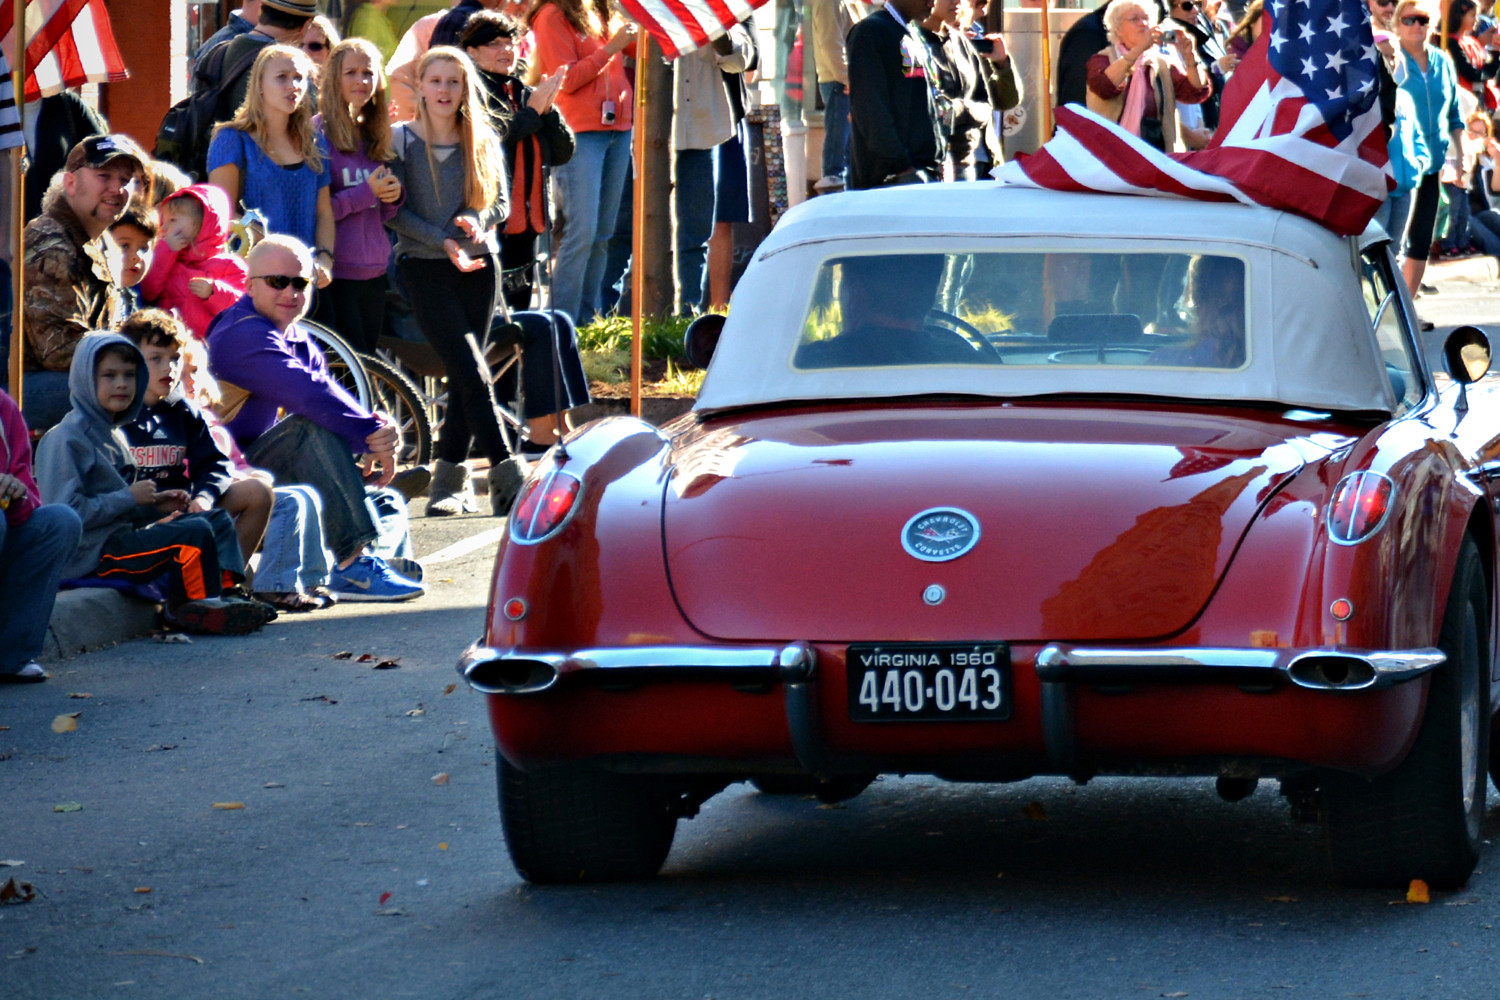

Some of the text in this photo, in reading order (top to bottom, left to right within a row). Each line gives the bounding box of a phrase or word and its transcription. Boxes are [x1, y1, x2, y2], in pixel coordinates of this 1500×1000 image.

[917, 516, 968, 532] CHEVROLET
[914, 542, 962, 556] CORVETTE
[860, 653, 996, 667] VIRGINIA 1960
